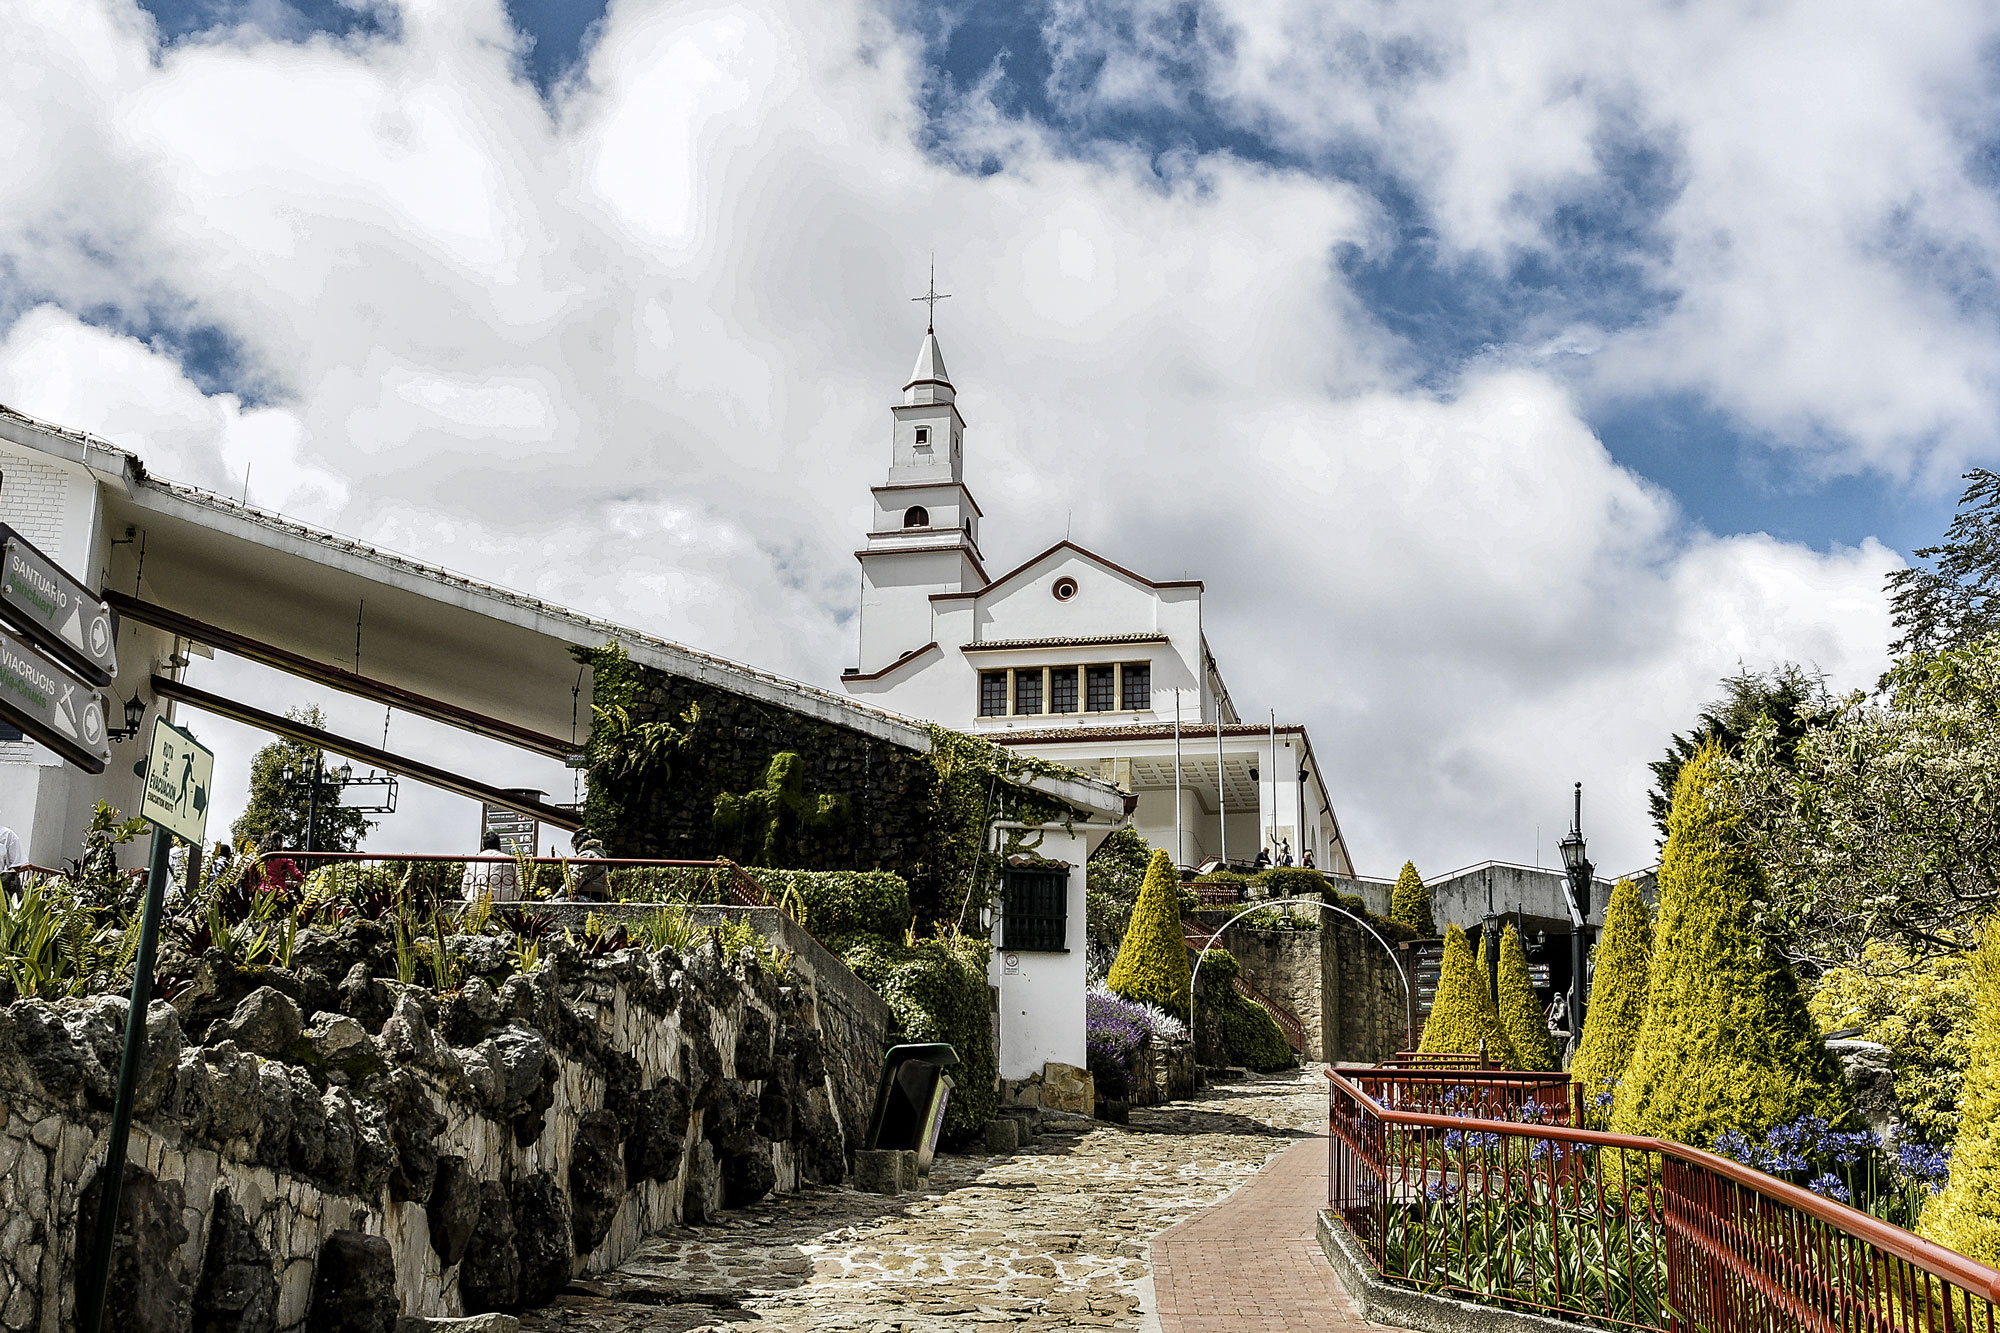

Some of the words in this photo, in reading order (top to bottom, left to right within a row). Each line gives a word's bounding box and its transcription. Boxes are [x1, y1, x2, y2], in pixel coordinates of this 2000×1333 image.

[9, 573, 56, 620] Sanctuary
[12, 555, 67, 608] SANTUARIO
[2, 648, 55, 695] VIACRUCIS
[162, 741, 174, 761] RUTA
[162, 760, 169, 778] DE
[164, 800, 174, 814] ROUTE
